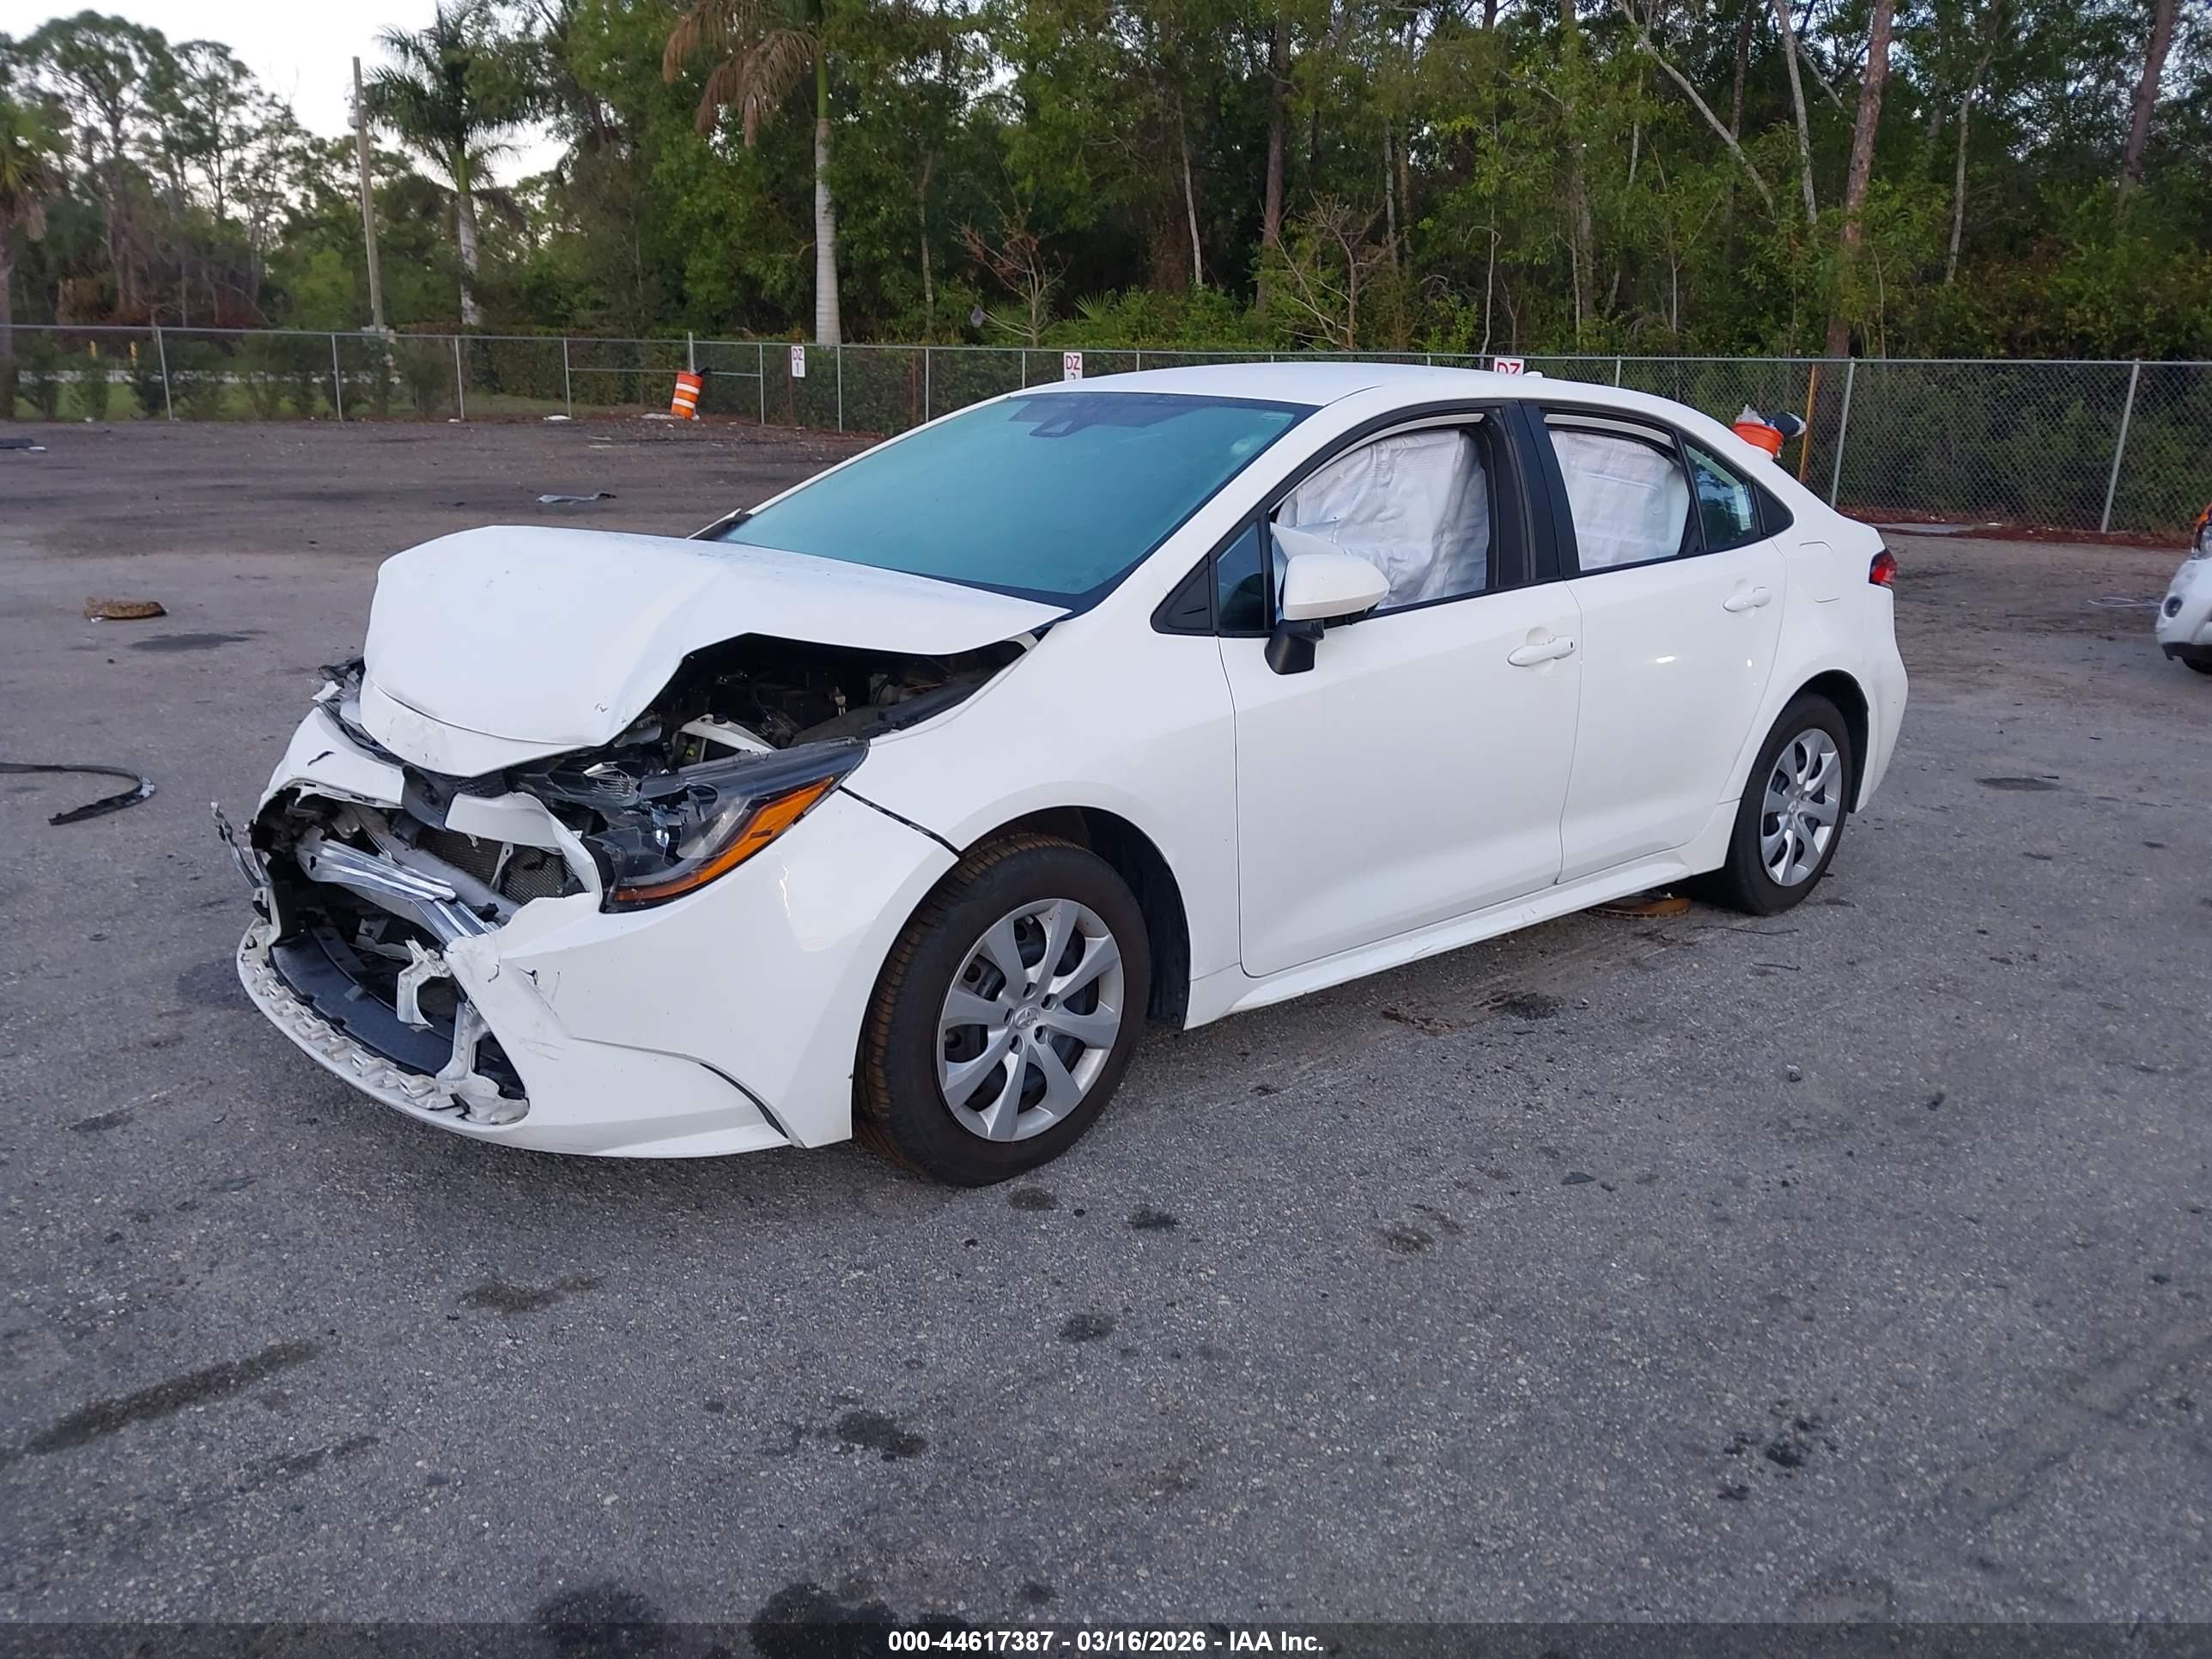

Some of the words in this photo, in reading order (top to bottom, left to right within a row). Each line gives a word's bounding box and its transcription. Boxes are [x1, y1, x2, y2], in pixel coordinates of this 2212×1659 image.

[793, 348, 803, 361] DZ
[1066, 356, 1080, 370] DZ
[1497, 362, 1521, 374] DZ
